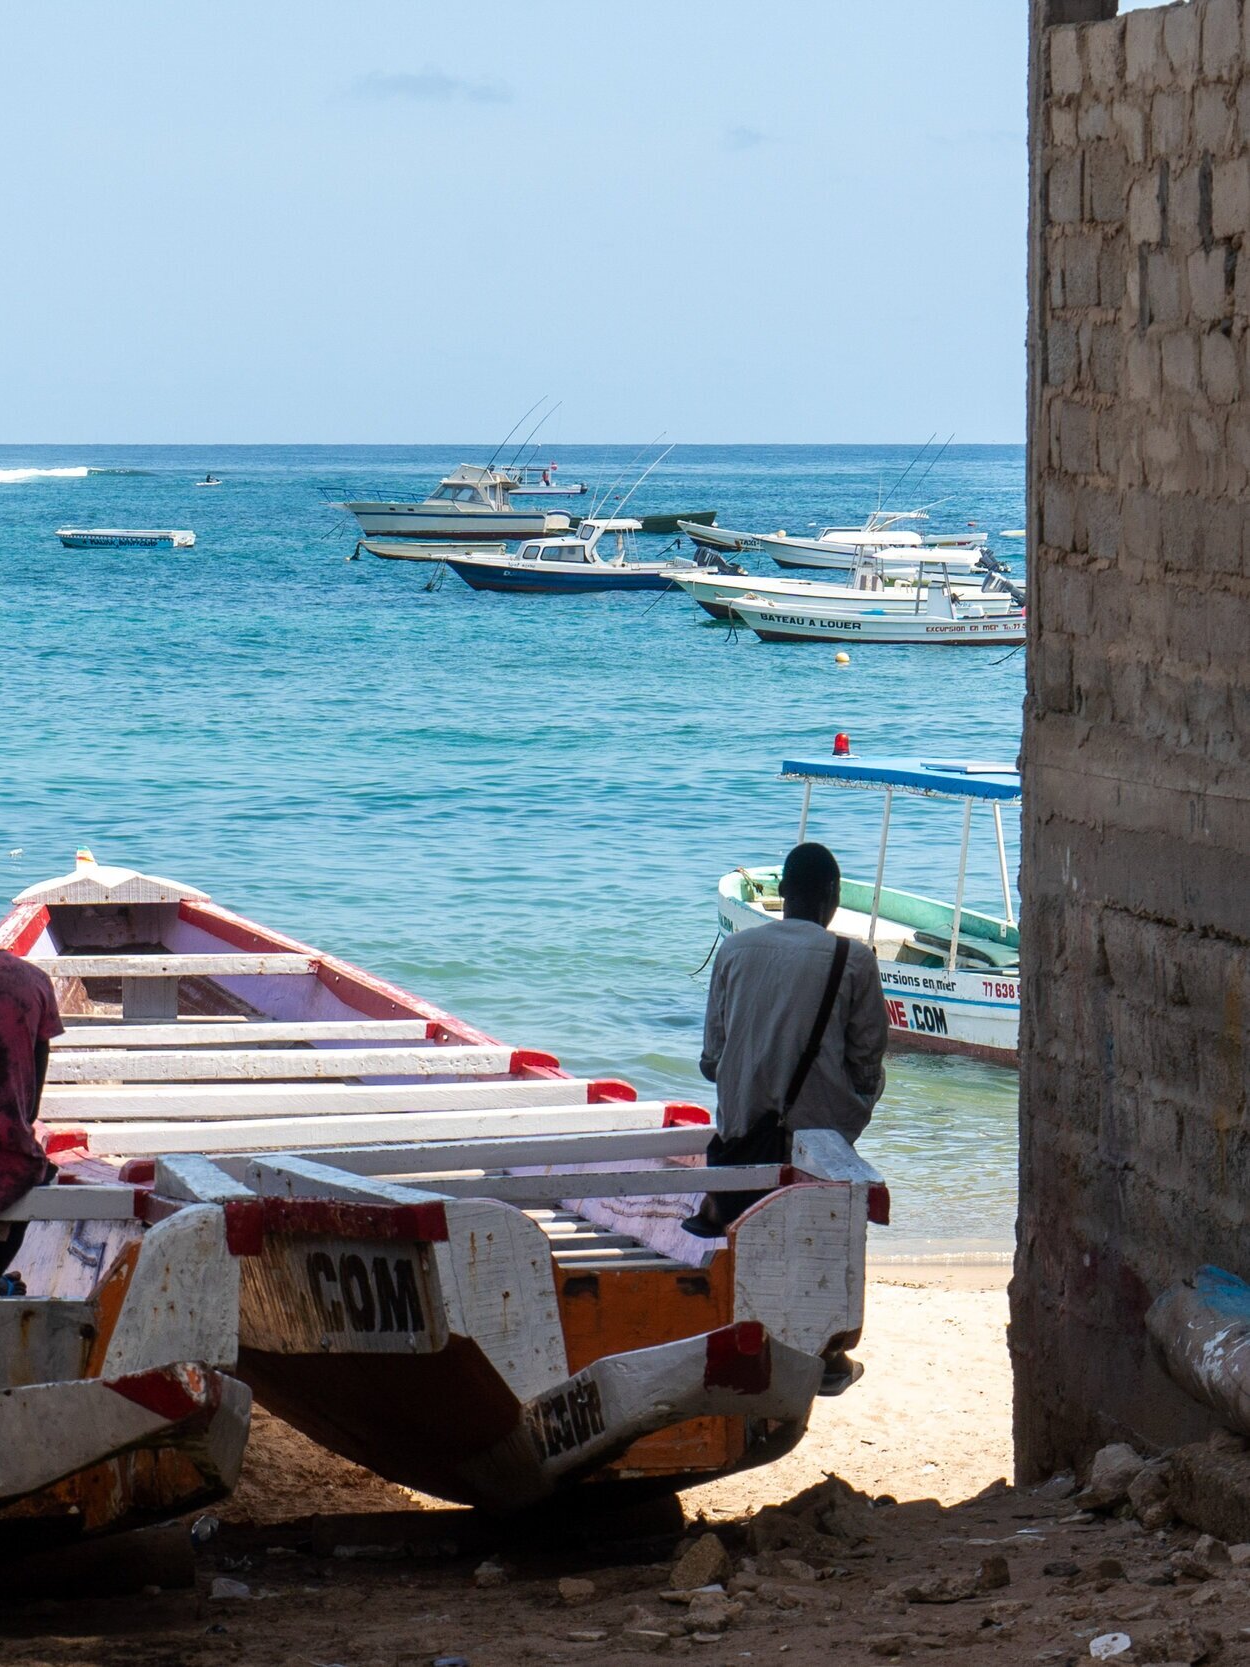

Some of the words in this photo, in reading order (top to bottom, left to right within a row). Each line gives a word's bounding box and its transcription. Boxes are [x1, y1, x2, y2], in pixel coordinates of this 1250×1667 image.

[760, 612, 805, 626] BATEAU
[809, 617, 817, 627] A
[820, 619, 862, 631] LOUER
[923, 977, 934, 989] en
[982, 981, 993, 997] 77
[995, 982, 1015, 999] 638
